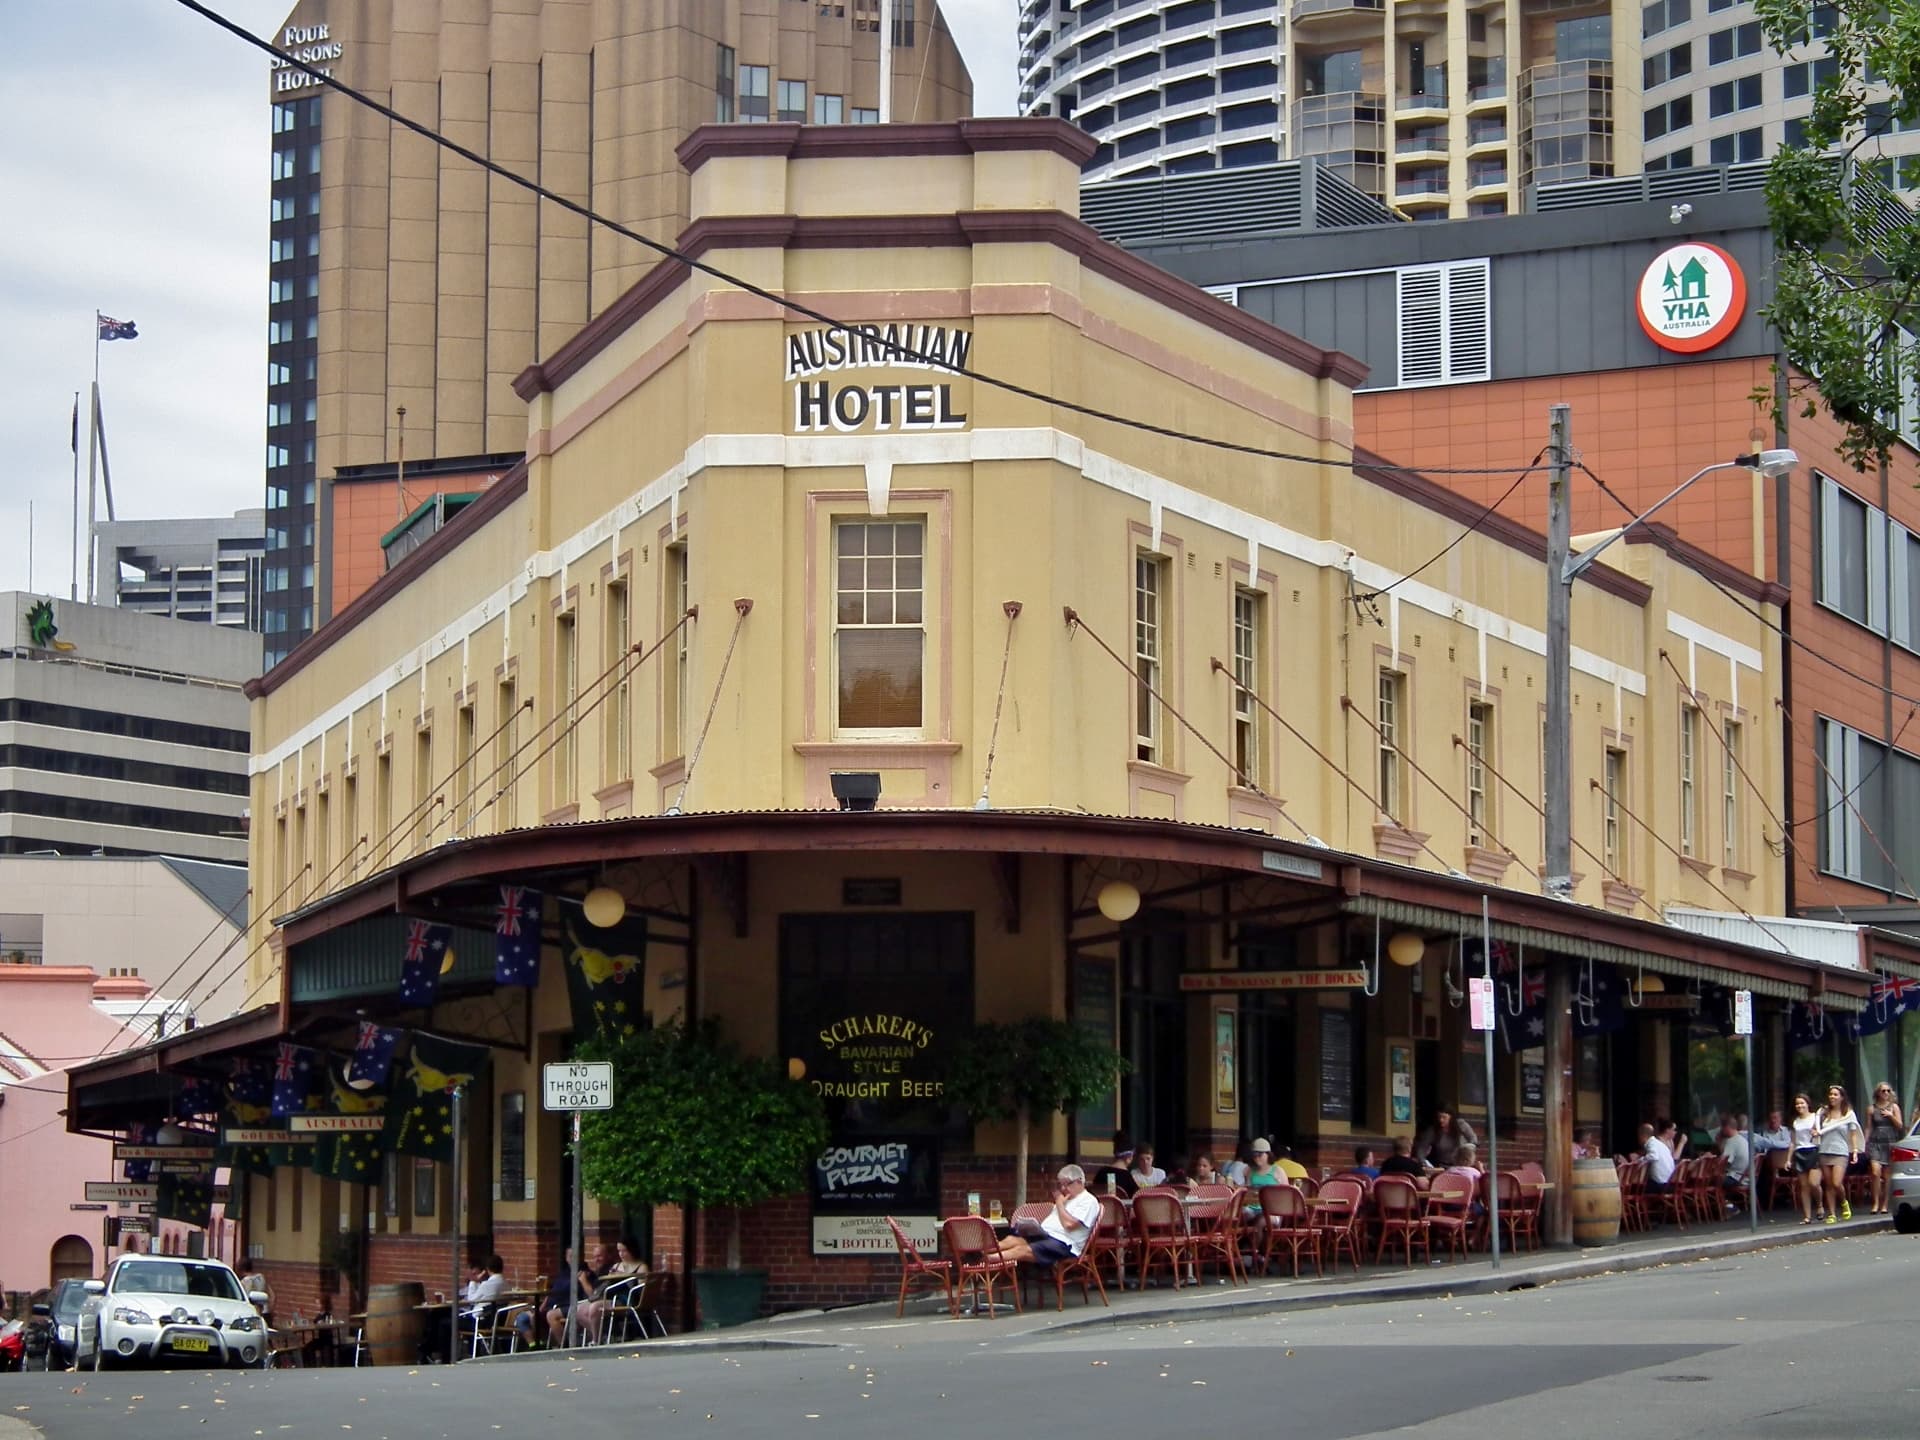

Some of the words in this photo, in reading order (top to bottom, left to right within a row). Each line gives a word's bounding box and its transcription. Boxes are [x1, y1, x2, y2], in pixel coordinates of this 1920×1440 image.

[284, 24, 329, 46] FOUR
[1663, 301, 1710, 321] YHA
[1663, 320, 1711, 330] AUSTRALIA
[784, 323, 973, 382] AUSTRALIAN
[794, 381, 968, 432] HOTEL
[819, 1014, 934, 1050] SCHARER'S
[840, 1046, 914, 1059] BAVARIAN
[569, 1066, 588, 1077] NO
[853, 1060, 901, 1073] STYLE
[549, 1080, 608, 1091] THROUGH
[811, 1080, 890, 1098] DRAUGHT
[559, 1095, 599, 1106] ROAD
[817, 1142, 908, 1171] GOURMET
[841, 1237, 893, 1249] BOTTLE
